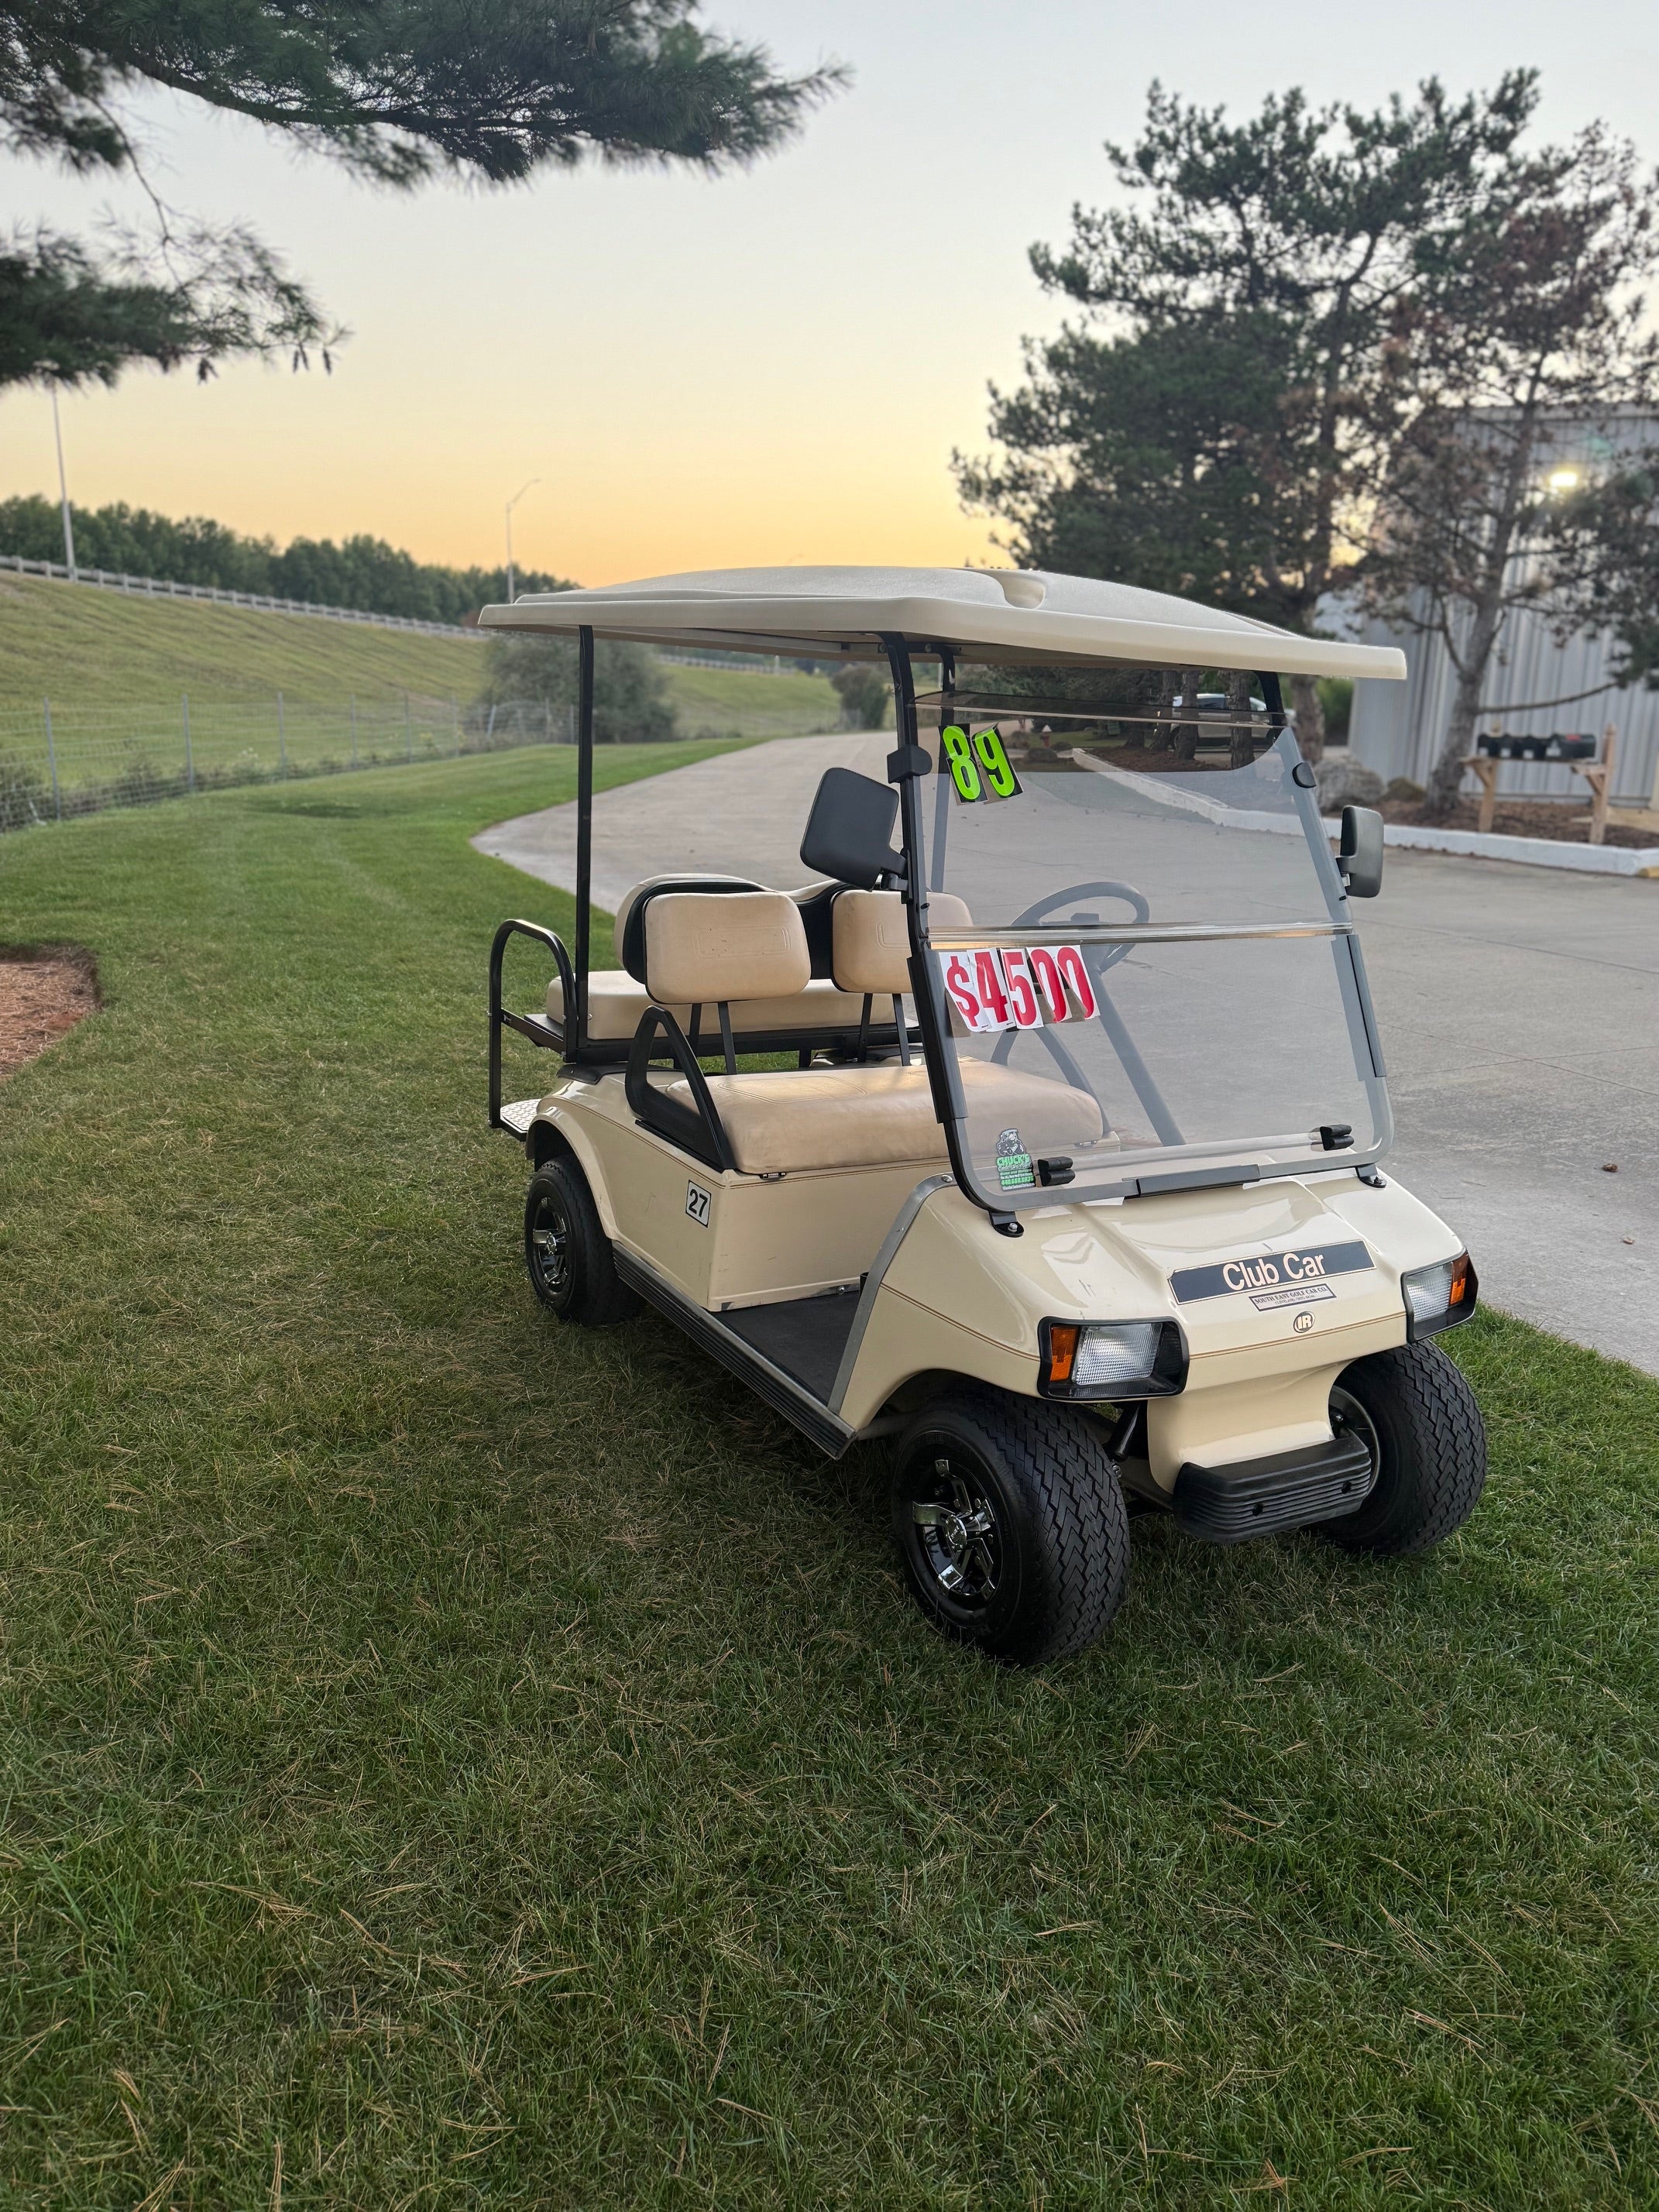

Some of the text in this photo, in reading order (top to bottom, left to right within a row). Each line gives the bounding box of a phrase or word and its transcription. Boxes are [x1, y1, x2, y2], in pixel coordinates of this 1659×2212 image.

[942, 724, 1015, 800] 89
[946, 946, 1094, 1027] $4500
[688, 1188, 708, 1218] 27
[1222, 1252, 1324, 1291] Club Car
[1254, 1296, 1276, 1304] SOUTH
[1297, 1314, 1313, 1330] IR
